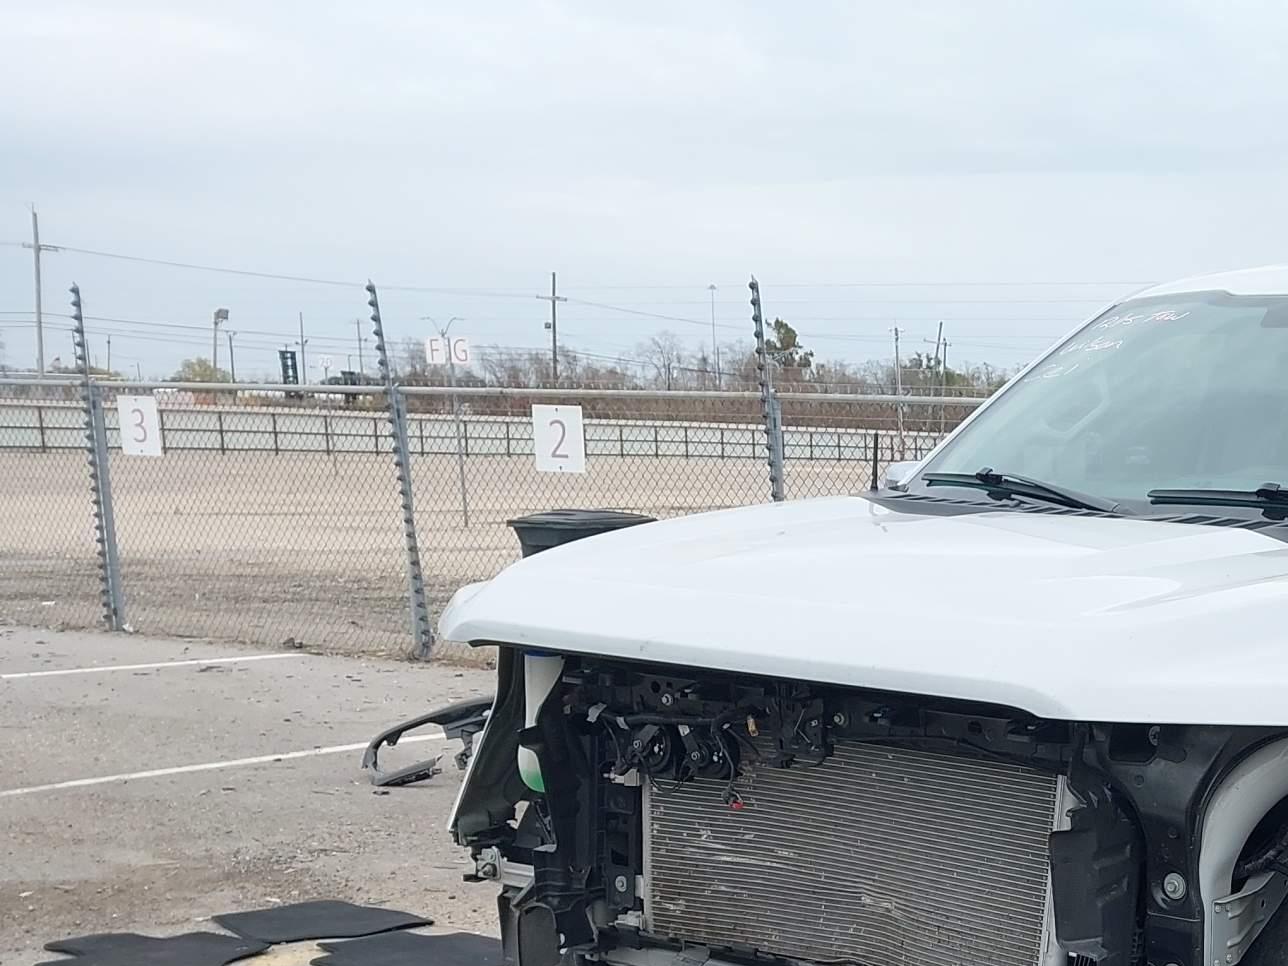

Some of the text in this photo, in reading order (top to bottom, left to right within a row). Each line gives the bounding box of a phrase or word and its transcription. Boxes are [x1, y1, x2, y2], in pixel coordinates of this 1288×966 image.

[430, 339, 440, 362] F
[453, 338, 468, 362] G
[131, 407, 149, 443] 3
[548, 418, 570, 460] 2
